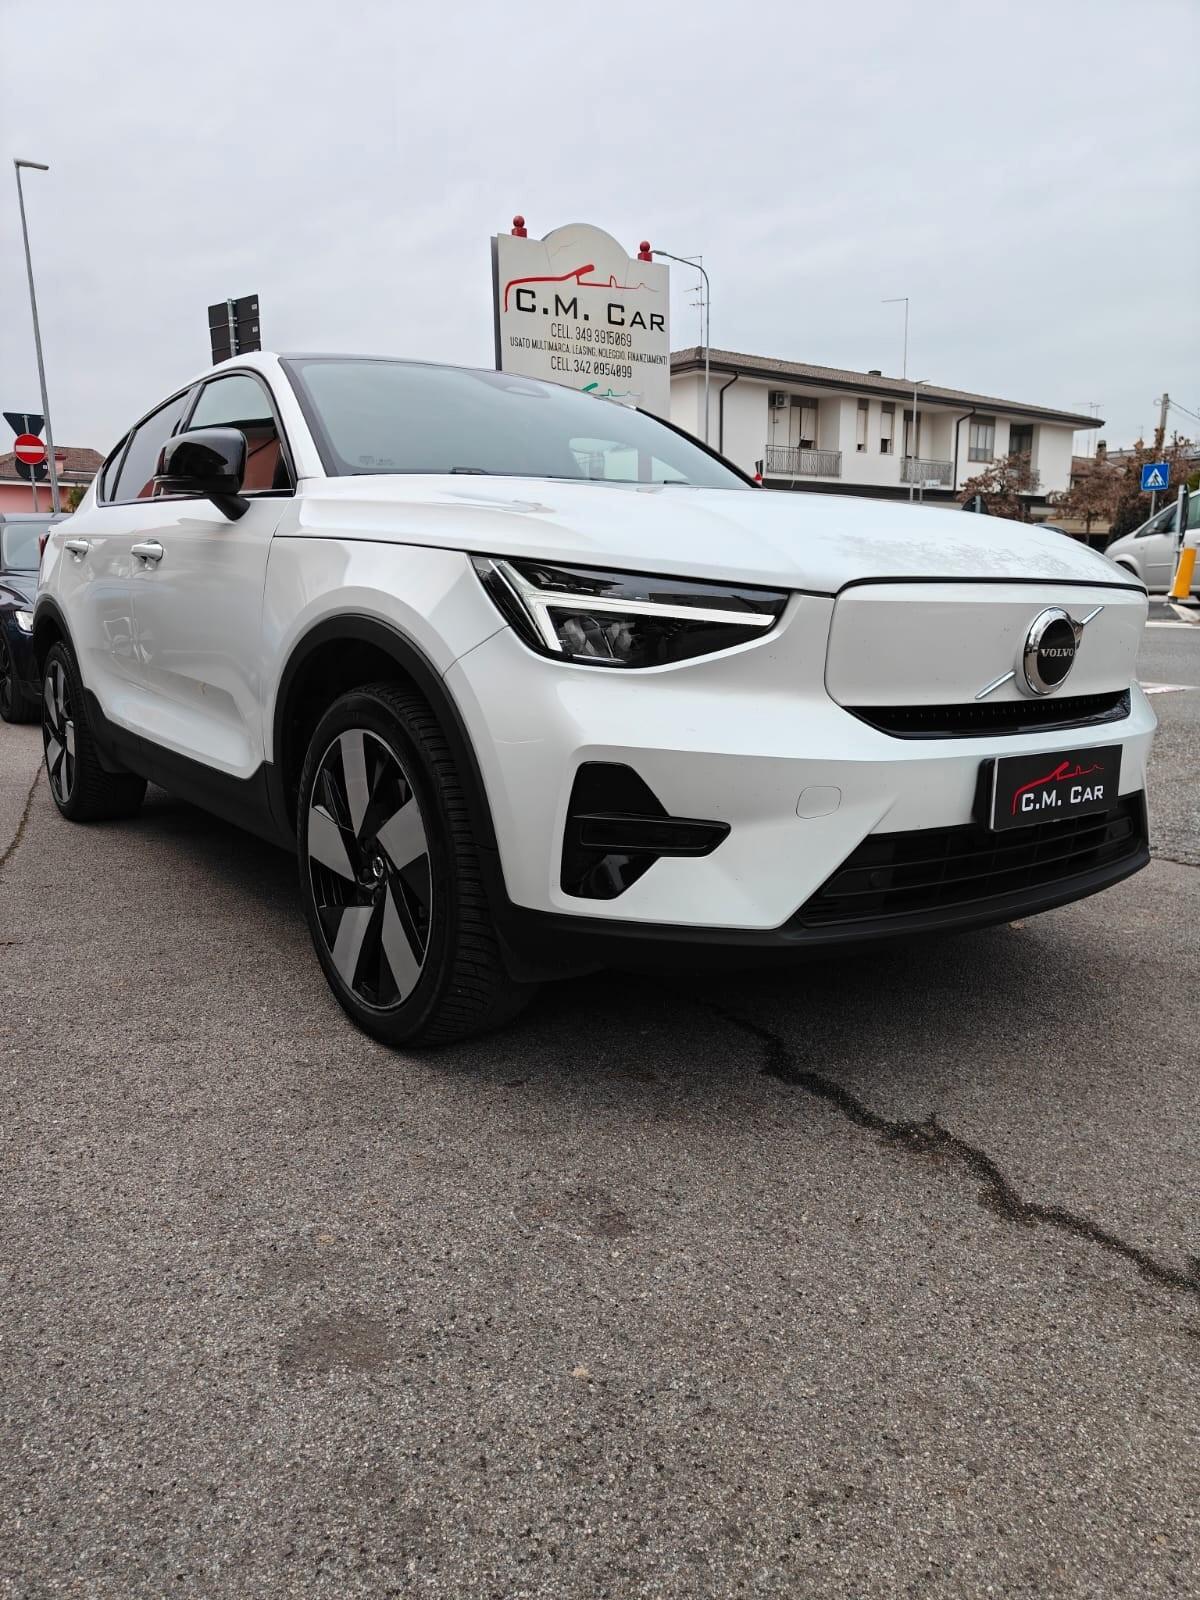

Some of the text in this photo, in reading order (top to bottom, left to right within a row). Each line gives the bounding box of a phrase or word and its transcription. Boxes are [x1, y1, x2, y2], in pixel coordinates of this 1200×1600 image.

[515, 288, 590, 321] C.M.
[551, 323, 632, 348] CELL. 349 3915069
[510, 336, 531, 348] USATO
[627, 352, 668, 366] FINANZIAMENTI
[551, 356, 633, 379] CELL. 342 0954099
[1040, 647, 1075, 657] VOLVO
[1021, 790, 1062, 812] C.M.
